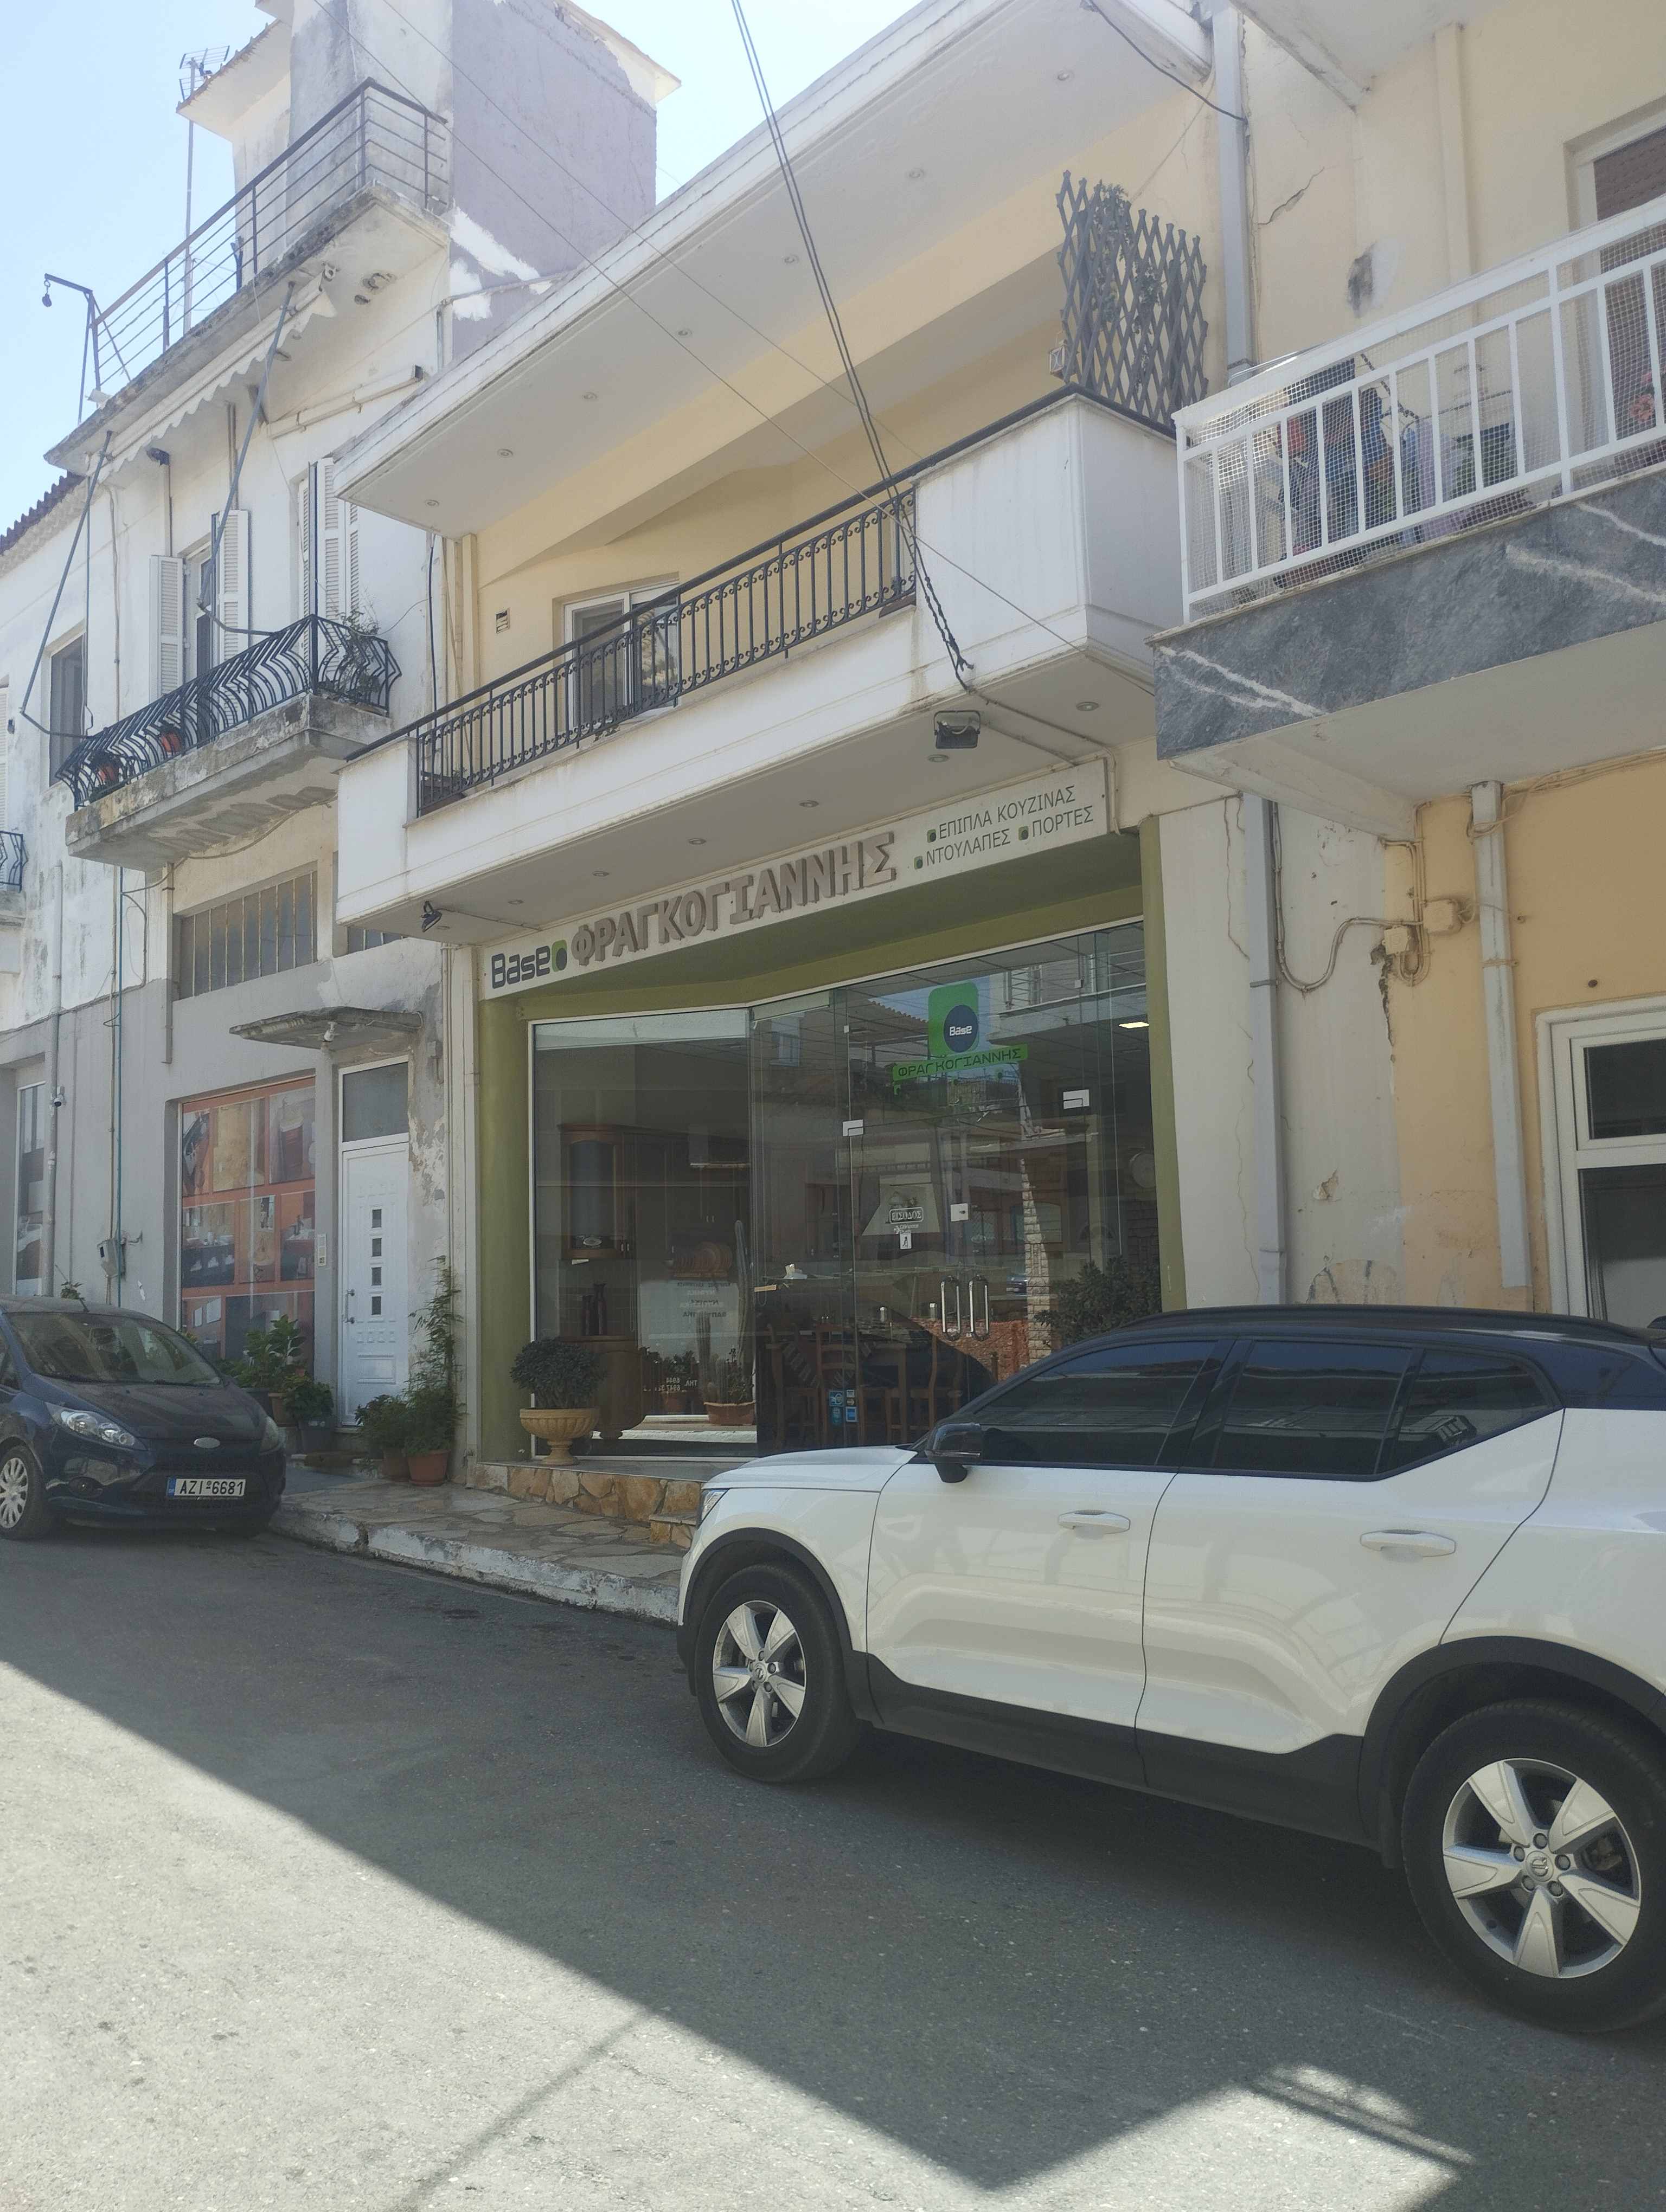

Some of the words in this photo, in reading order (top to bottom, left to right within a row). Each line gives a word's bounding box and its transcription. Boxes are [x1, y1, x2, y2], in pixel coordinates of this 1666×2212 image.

[938, 810, 992, 840] ΕΠΙΠΛΑ
[997, 785, 1075, 823] ΚΟΥΖΙΝΑΣ
[926, 828, 1011, 866] ΝΤΟΥΛΑΠΕΣ
[1032, 806, 1094, 837] ΠΟΡΤΕΣ
[491, 945, 551, 989] Base
[571, 831, 897, 967] ΦΡΑΓΚΟΓΙΑΝΝΗΣ
[949, 1025, 972, 1037] Base
[898, 1048, 1021, 1077] ΦΡΑΓΚΟΓΙΑΝΝΗΣ
[892, 1210, 922, 1221] ΕΙΣΟΔΟΣ
